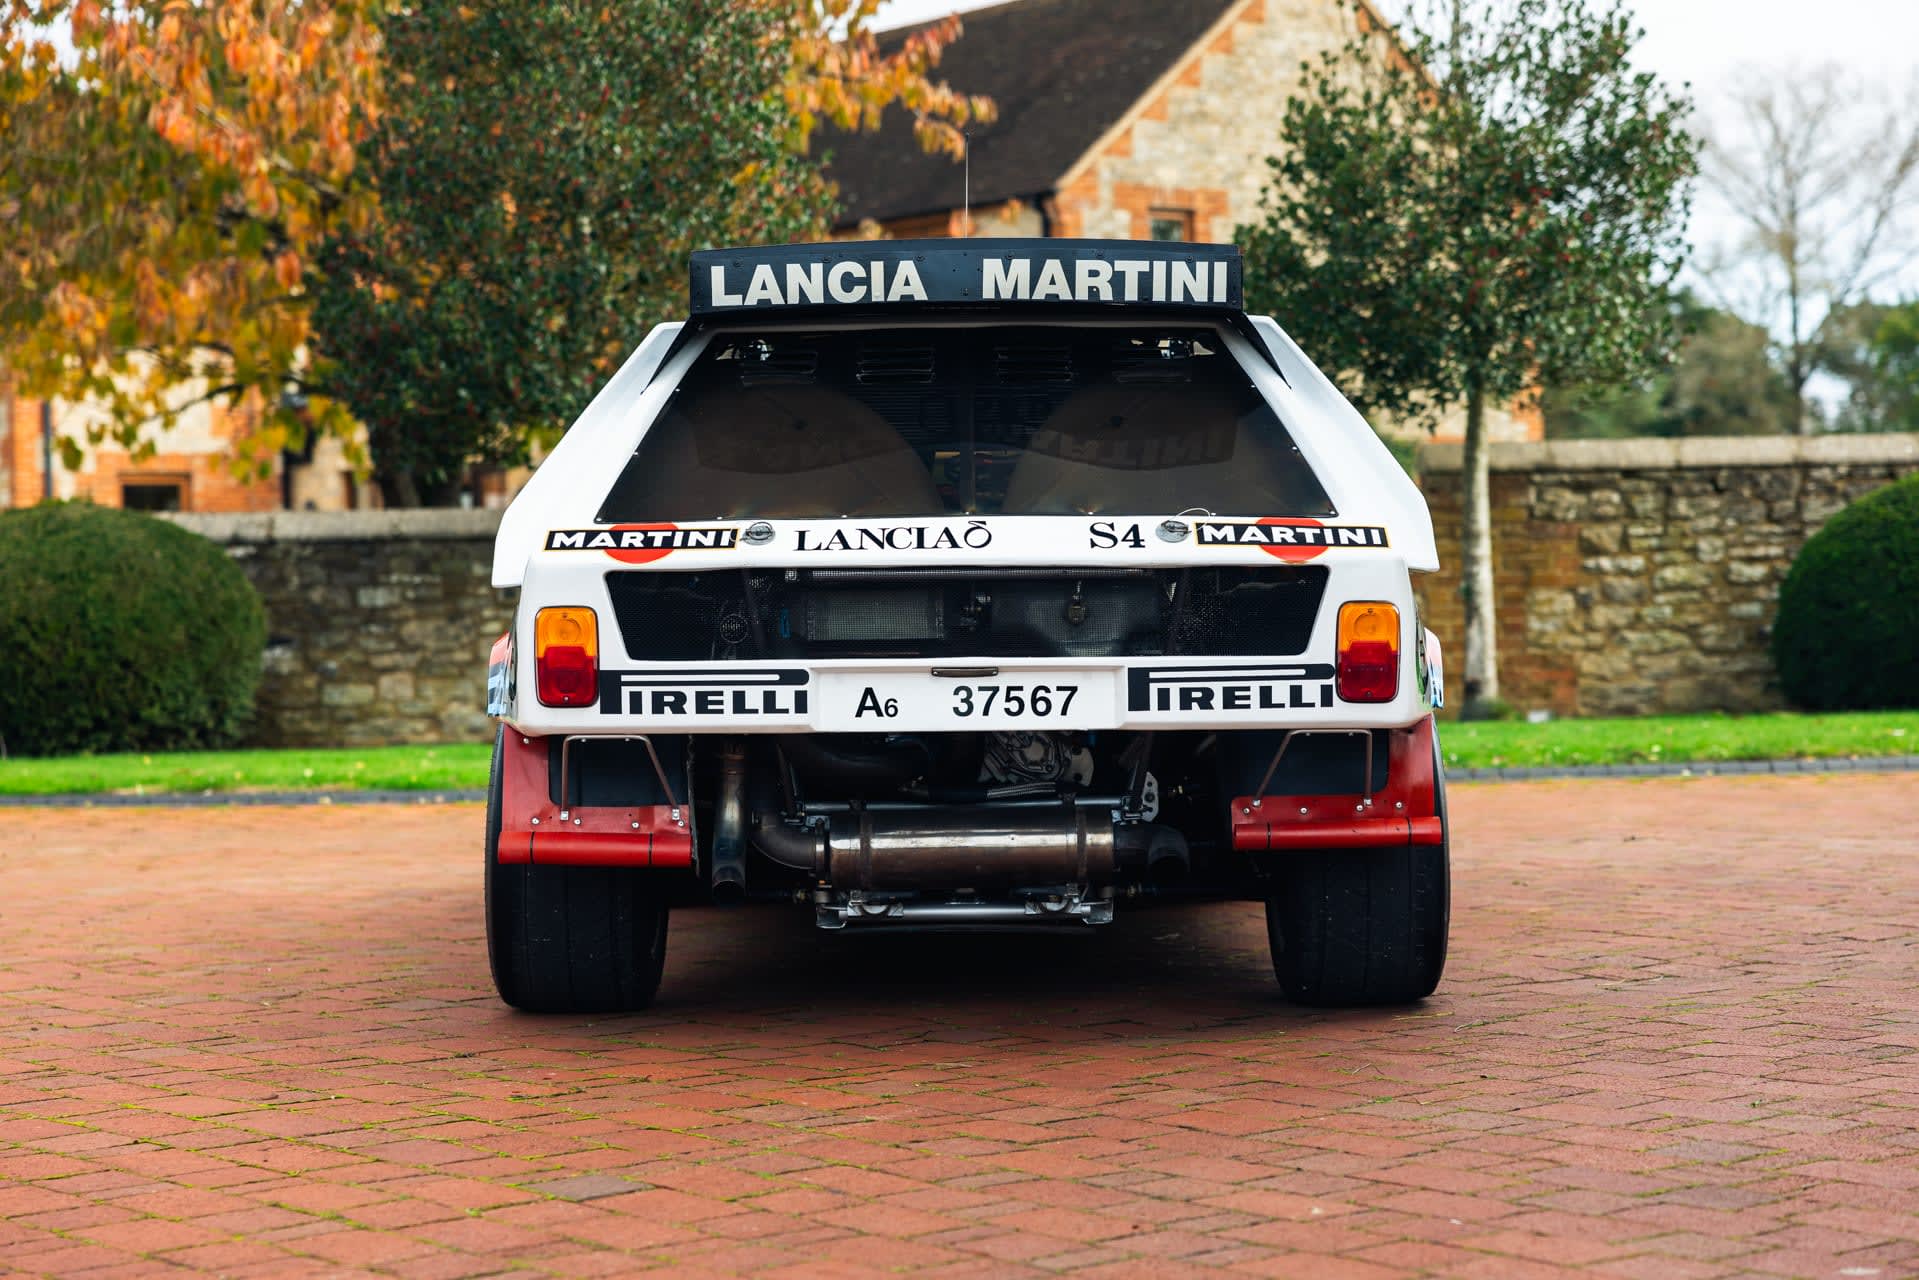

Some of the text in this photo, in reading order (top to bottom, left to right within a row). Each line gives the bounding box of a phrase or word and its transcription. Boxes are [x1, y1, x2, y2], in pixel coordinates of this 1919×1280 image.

[710, 258, 1228, 307] LANCIA MARTINI
[551, 529, 733, 548] MARTINI
[1089, 521, 1146, 549] S4
[1202, 524, 1383, 545] MARTINI
[599, 668, 810, 715] PIRELLI
[854, 685, 1079, 718] A6 37567
[1127, 663, 1336, 712] PIRELLI
